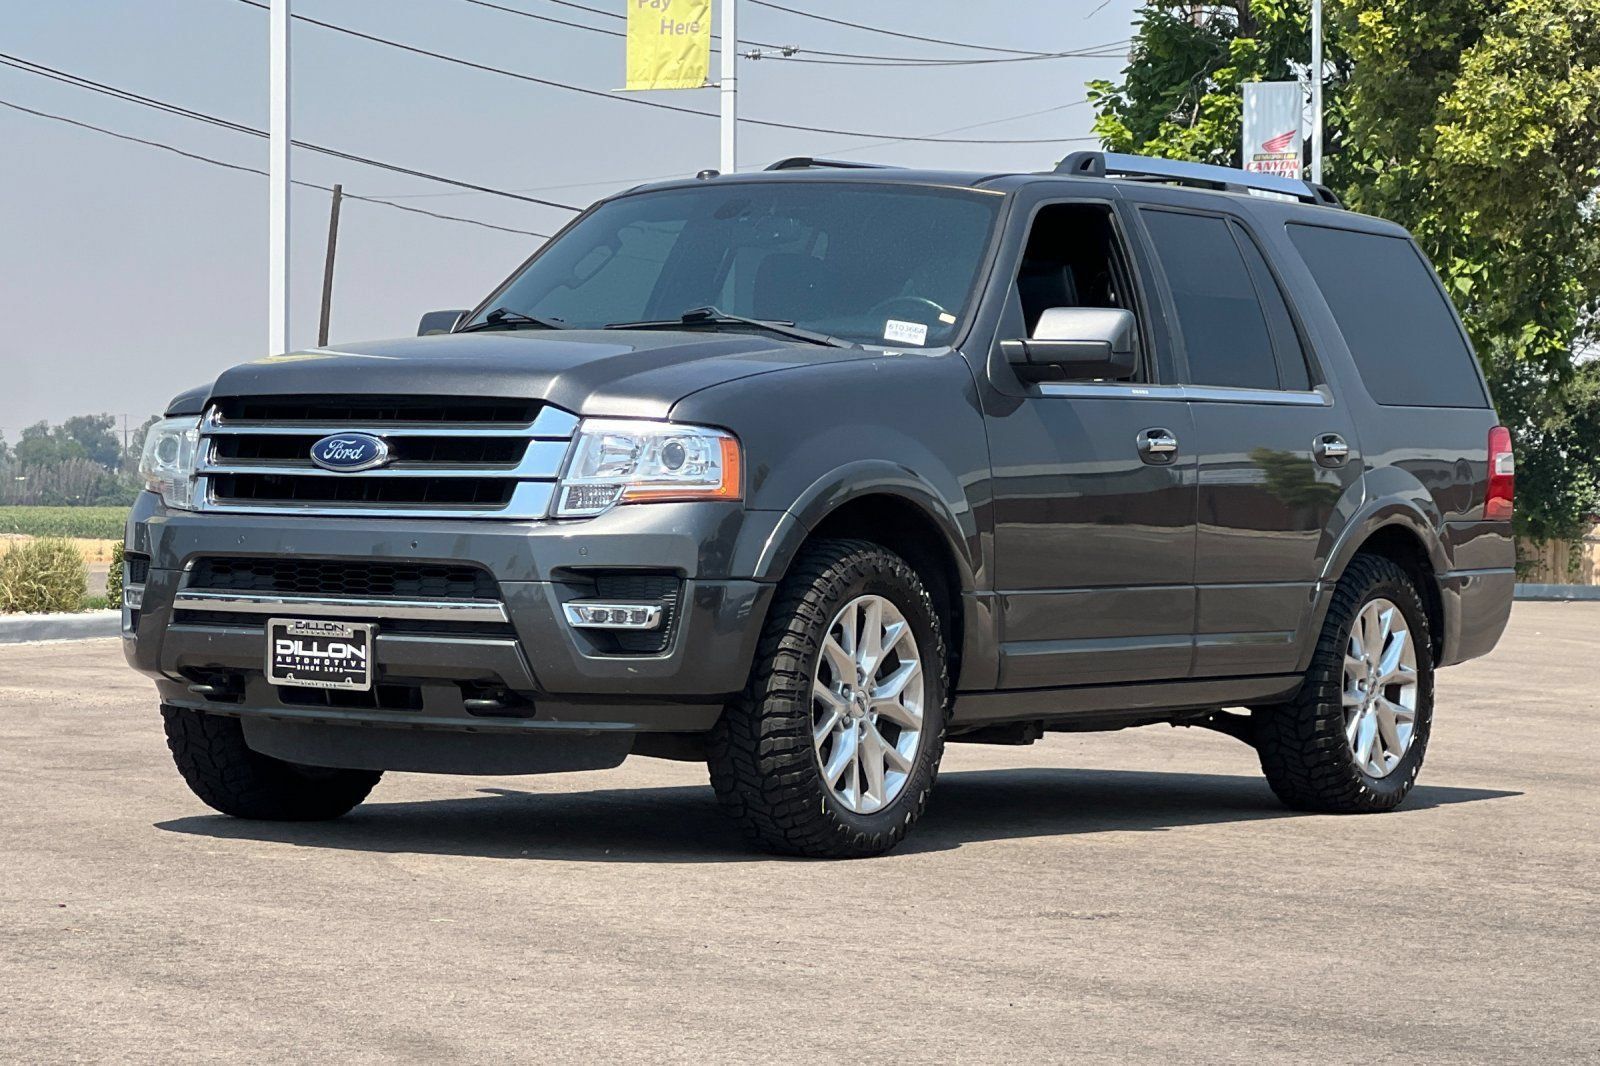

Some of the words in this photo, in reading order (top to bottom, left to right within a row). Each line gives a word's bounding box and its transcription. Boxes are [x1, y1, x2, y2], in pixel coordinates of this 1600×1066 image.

[638, 0, 671, 12] Pay
[660, 19, 701, 36] Here
[1246, 160, 1300, 171] CANYON
[323, 439, 365, 460] Ford
[295, 621, 344, 632] DILLON
[276, 639, 366, 660] DILLON
[276, 656, 366, 668] AUTOMOTIVE
[296, 664, 320, 672] SINCE
